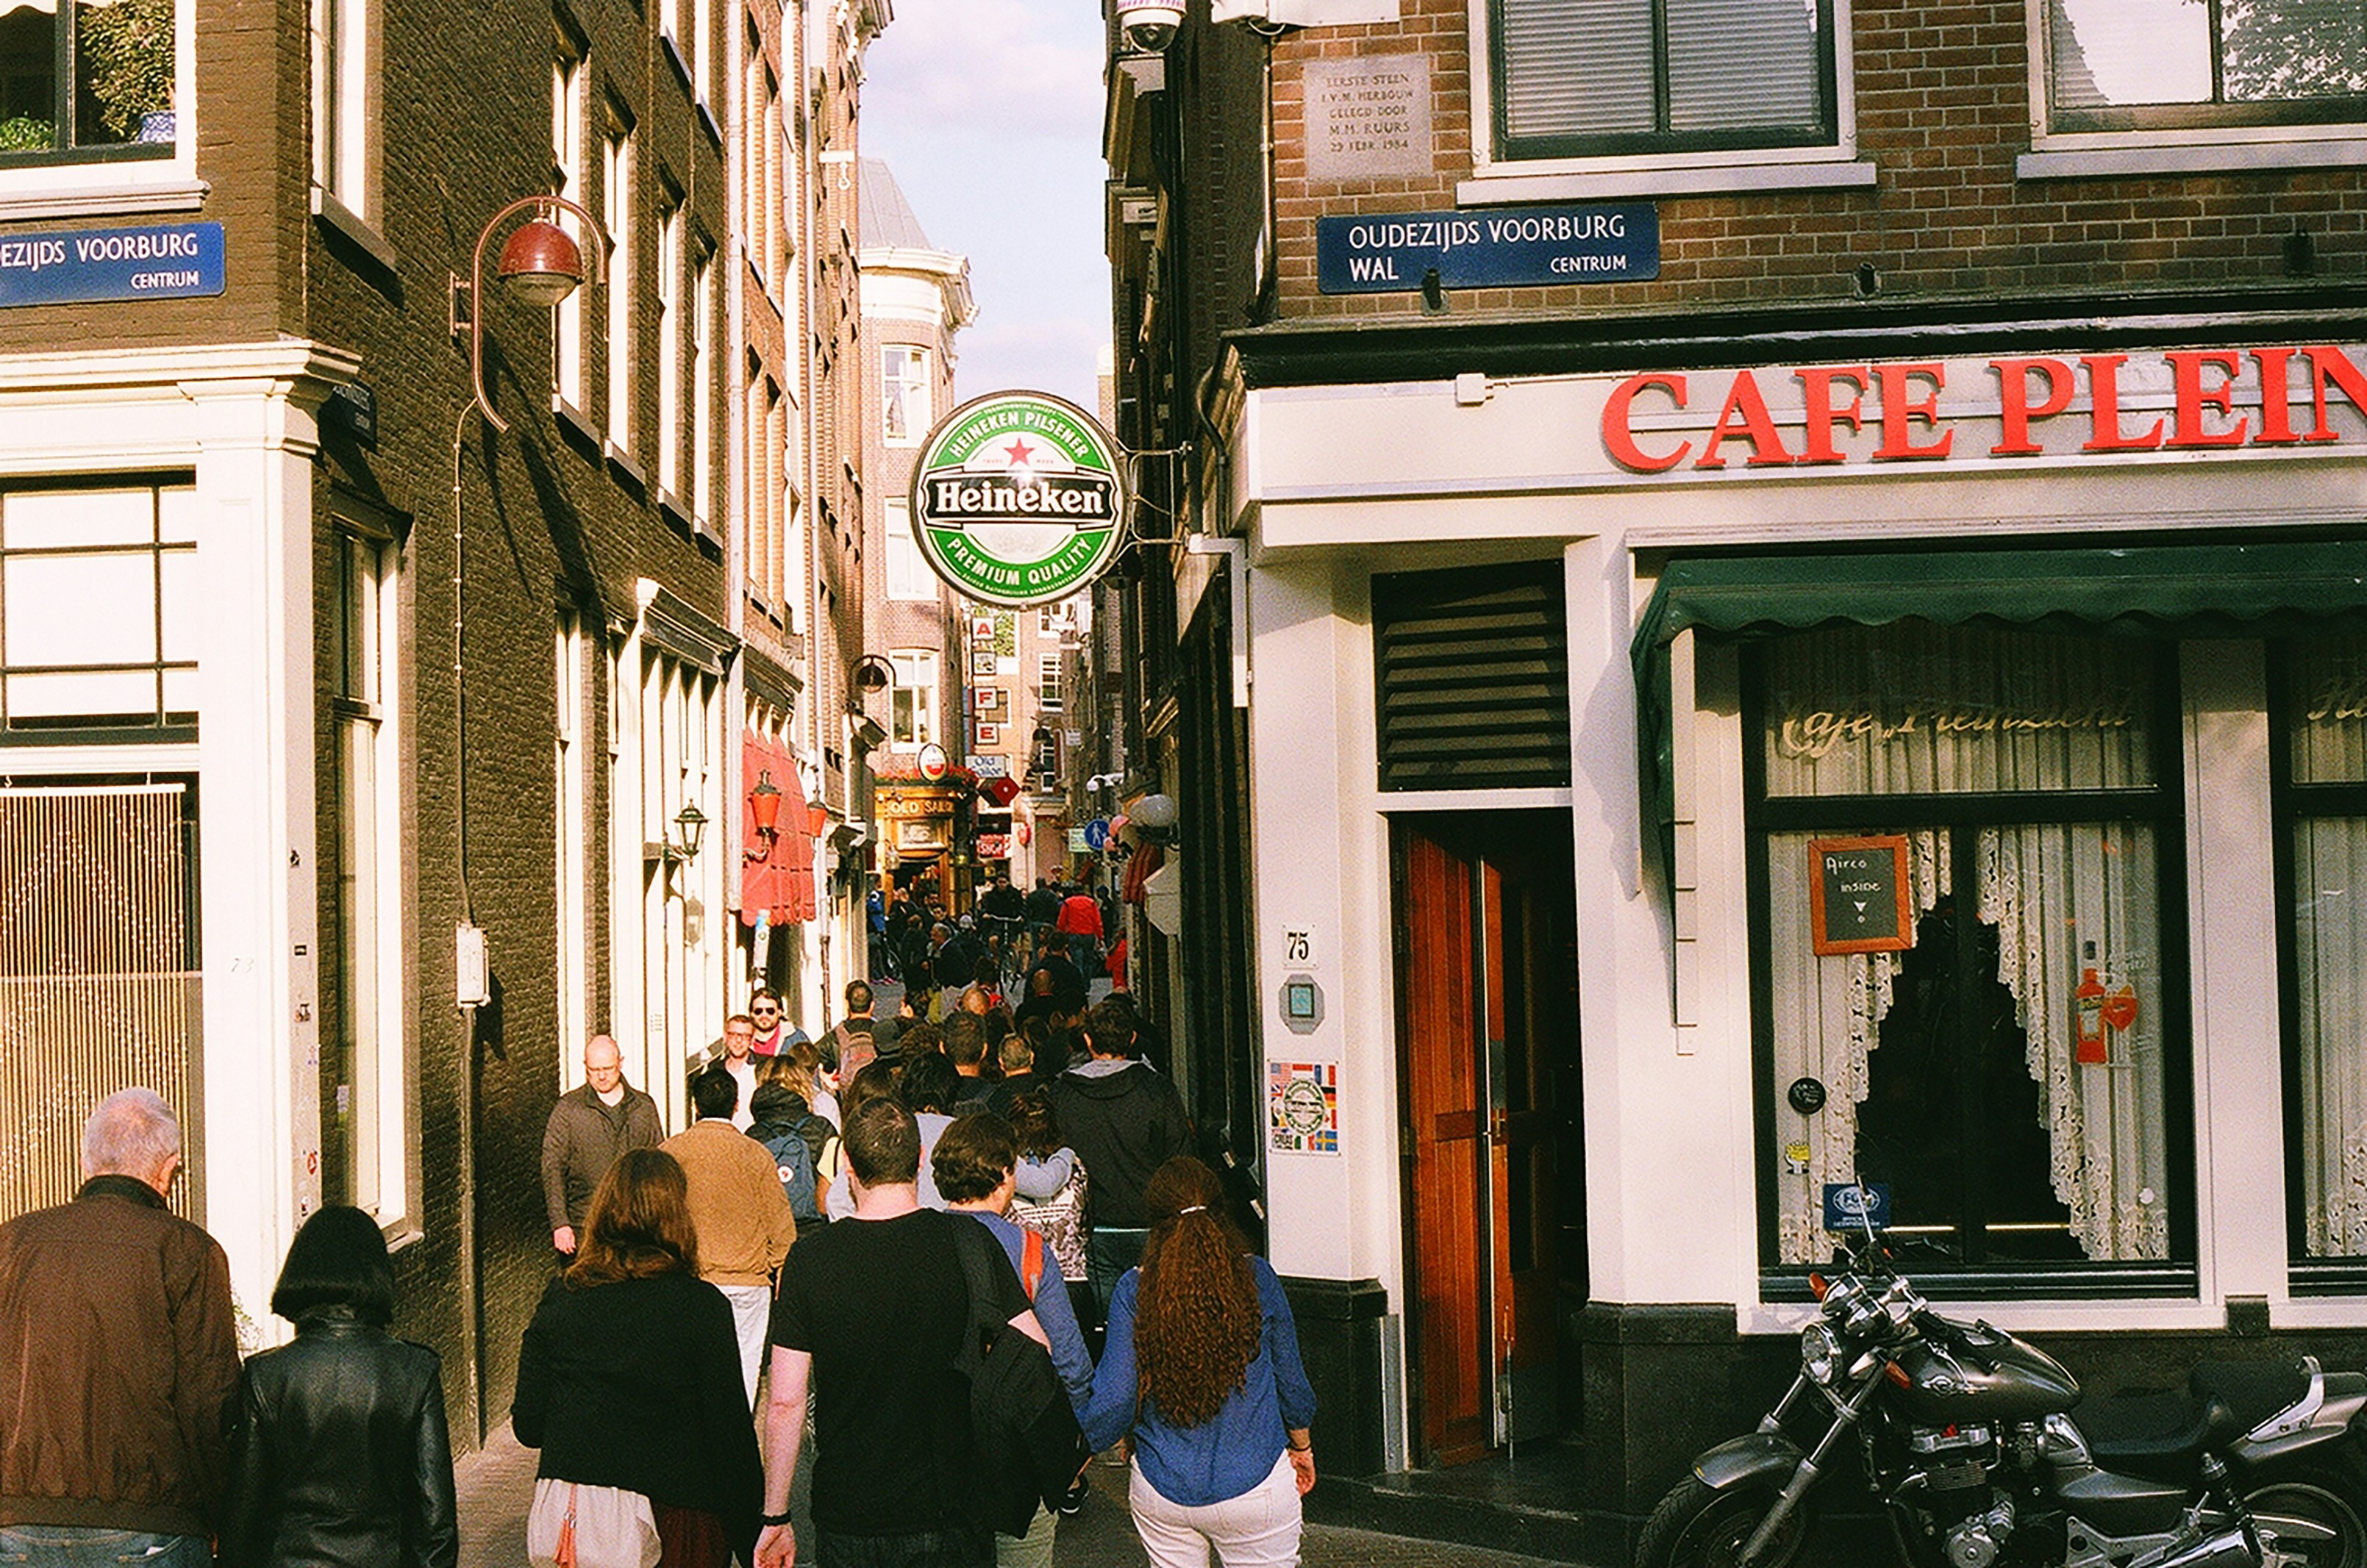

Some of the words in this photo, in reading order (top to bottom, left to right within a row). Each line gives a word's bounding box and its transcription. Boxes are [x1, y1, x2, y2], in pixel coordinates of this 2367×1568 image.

[1364, 121, 1410, 134] RUURS
[1349, 221, 1480, 253] OUDEZIJDS
[1488, 215, 1624, 243] VOORBURG
[0, 240, 65, 271] EZIJDS
[76, 233, 198, 262] VOORBURG
[130, 271, 199, 289] CENTRUM
[1349, 257, 1399, 282] WAL
[1550, 255, 1627, 273] CENTRUM
[1602, 362, 1954, 470] CAFE
[948, 411, 1019, 459] HEINEKEN
[1024, 411, 1090, 459] PILSENER
[935, 480, 1105, 514] Heineken
[947, 537, 1020, 586] PREMIUM
[1027, 537, 1093, 585] QUALITY
[890, 801, 919, 815] OLD
[1826, 856, 1867, 875] Airco
[1288, 931, 1310, 961] 75
